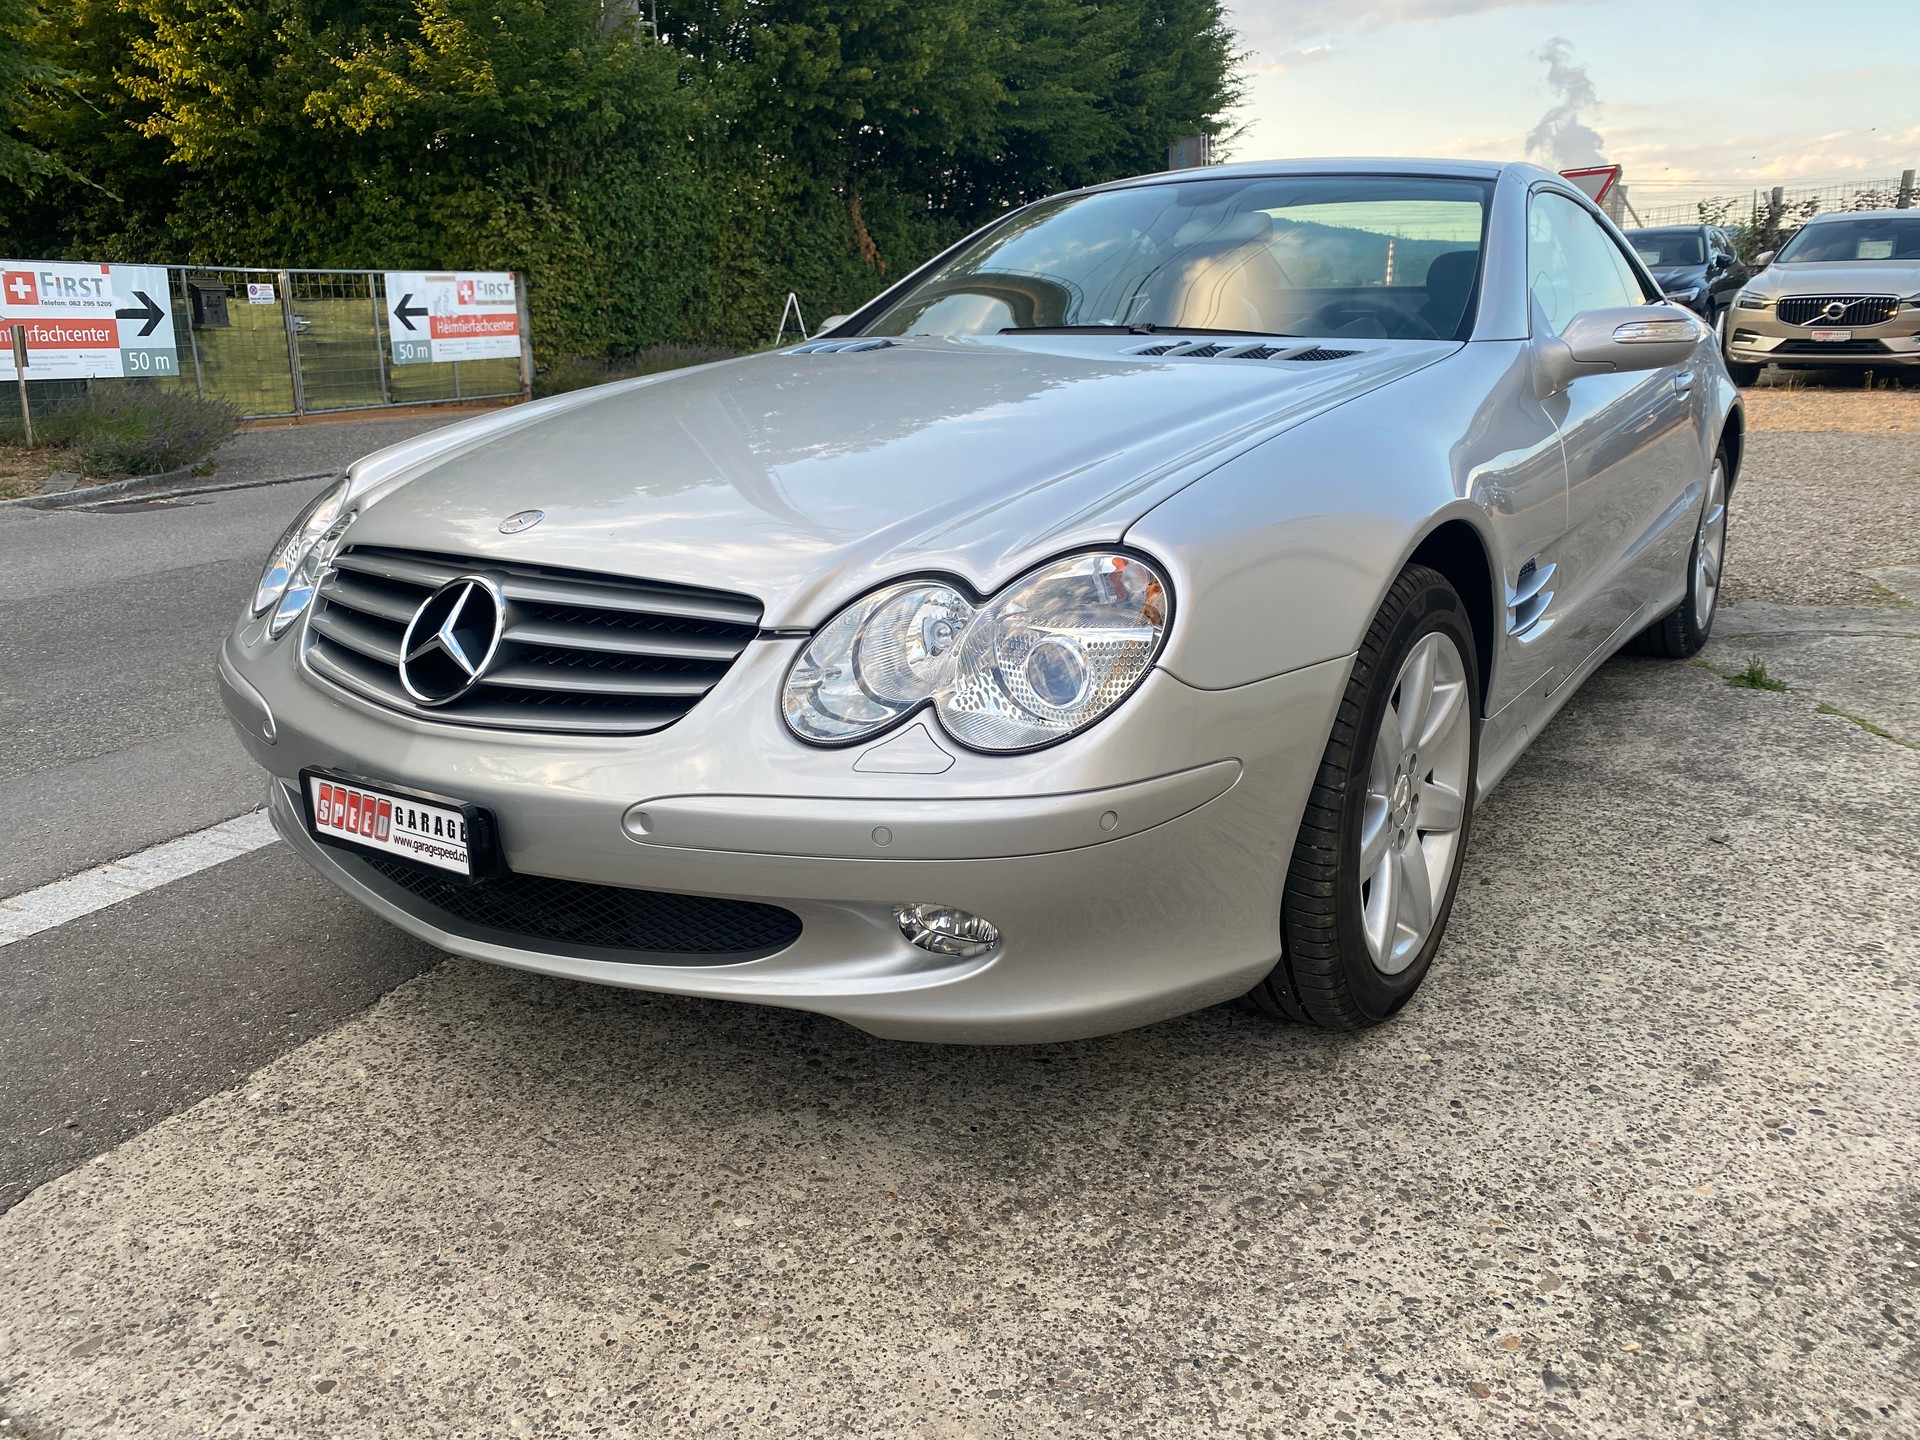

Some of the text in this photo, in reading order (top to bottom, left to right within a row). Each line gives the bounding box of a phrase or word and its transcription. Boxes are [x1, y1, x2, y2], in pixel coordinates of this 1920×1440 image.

[436, 321, 514, 333] Heimtierfachcenter
[129, 352, 150, 370] 50
[155, 356, 170, 370] m
[399, 344, 414, 359] 50
[417, 347, 429, 359] m
[319, 798, 389, 837] SPEED
[394, 806, 467, 843] GARAGE
[393, 834, 468, 864] www.garagespeed.ch
